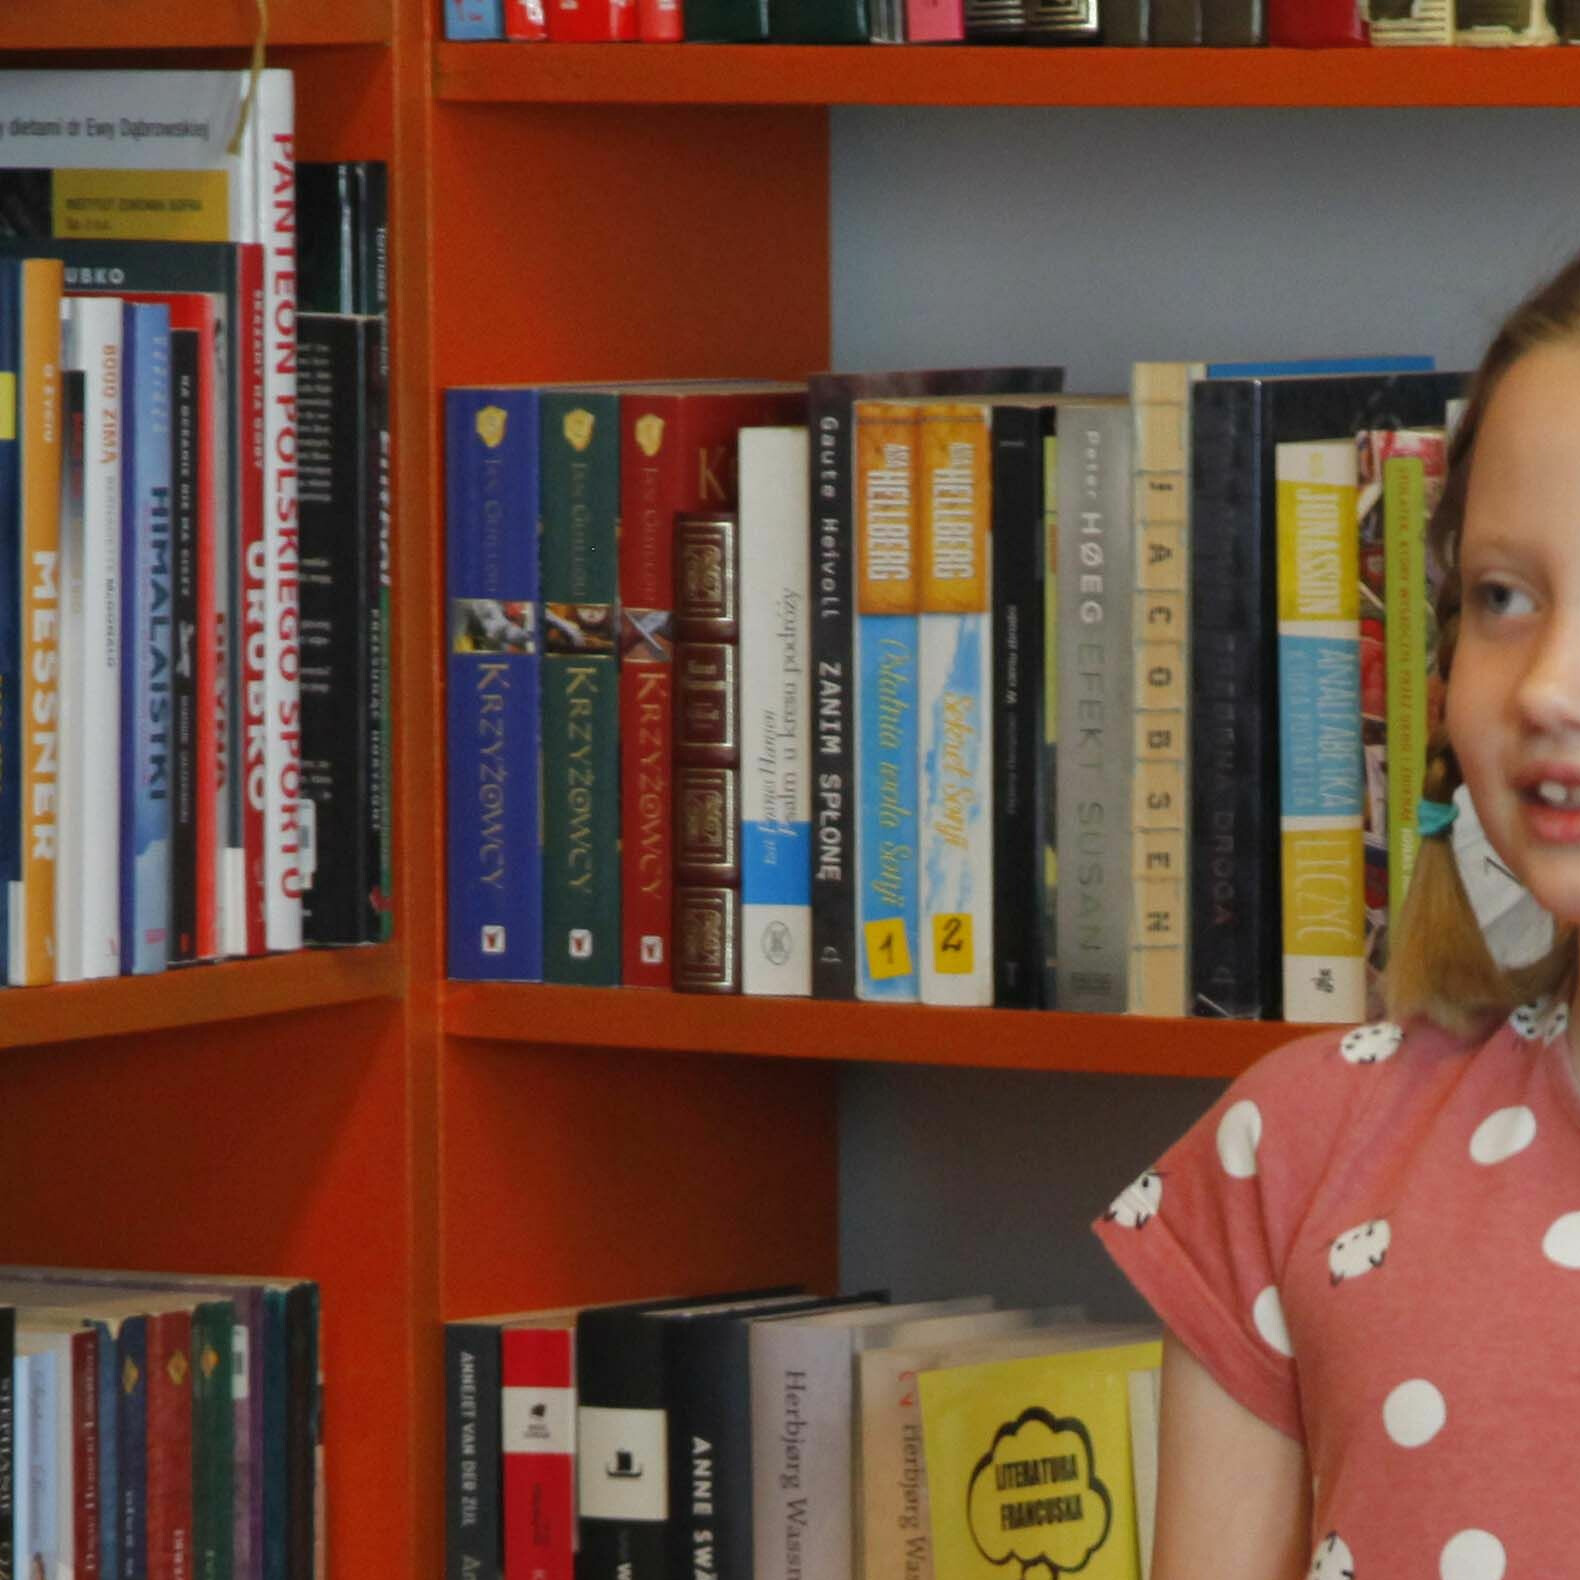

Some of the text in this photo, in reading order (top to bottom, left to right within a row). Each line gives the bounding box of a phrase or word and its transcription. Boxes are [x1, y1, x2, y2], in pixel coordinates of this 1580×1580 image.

[86, 119, 114, 139] Ewy
[273, 133, 301, 899] PANTEON POLSKIEGO SPORTU
[819, 416, 841, 618] Gaute Heivoll
[867, 470, 911, 581] HELLBERG
[932, 469, 975, 579] HELLBERG
[1080, 431, 1102, 624] Peter HØEG
[1296, 488, 1342, 613] JONASSON
[32, 551, 59, 860] MESSNER
[150, 486, 170, 800] HIMALAISTKI
[775, 587, 802, 762] u kresu podróży
[476, 662, 511, 889] KRZYŻOWCY
[565, 667, 598, 895] KRZYŻOWCY
[637, 671, 668, 900] KRZYŻOWCY
[817, 661, 842, 881] ZANIM SPŁONĘ
[1315, 648, 1357, 808] ANALFABETKA
[941, 918, 963, 952] 2
[1079, 802, 1104, 951] SUSAN
[1295, 840, 1358, 942] LICZYĆ
[879, 933, 895, 965] 1
[462, 1423, 476, 1455] VAN
[692, 1436, 713, 1515] ANNE
[780, 1371, 806, 1490] Herbjørg
[995, 1453, 1079, 1491] LITERATURA
[1001, 1495, 1083, 1531] FRANCUSKA
